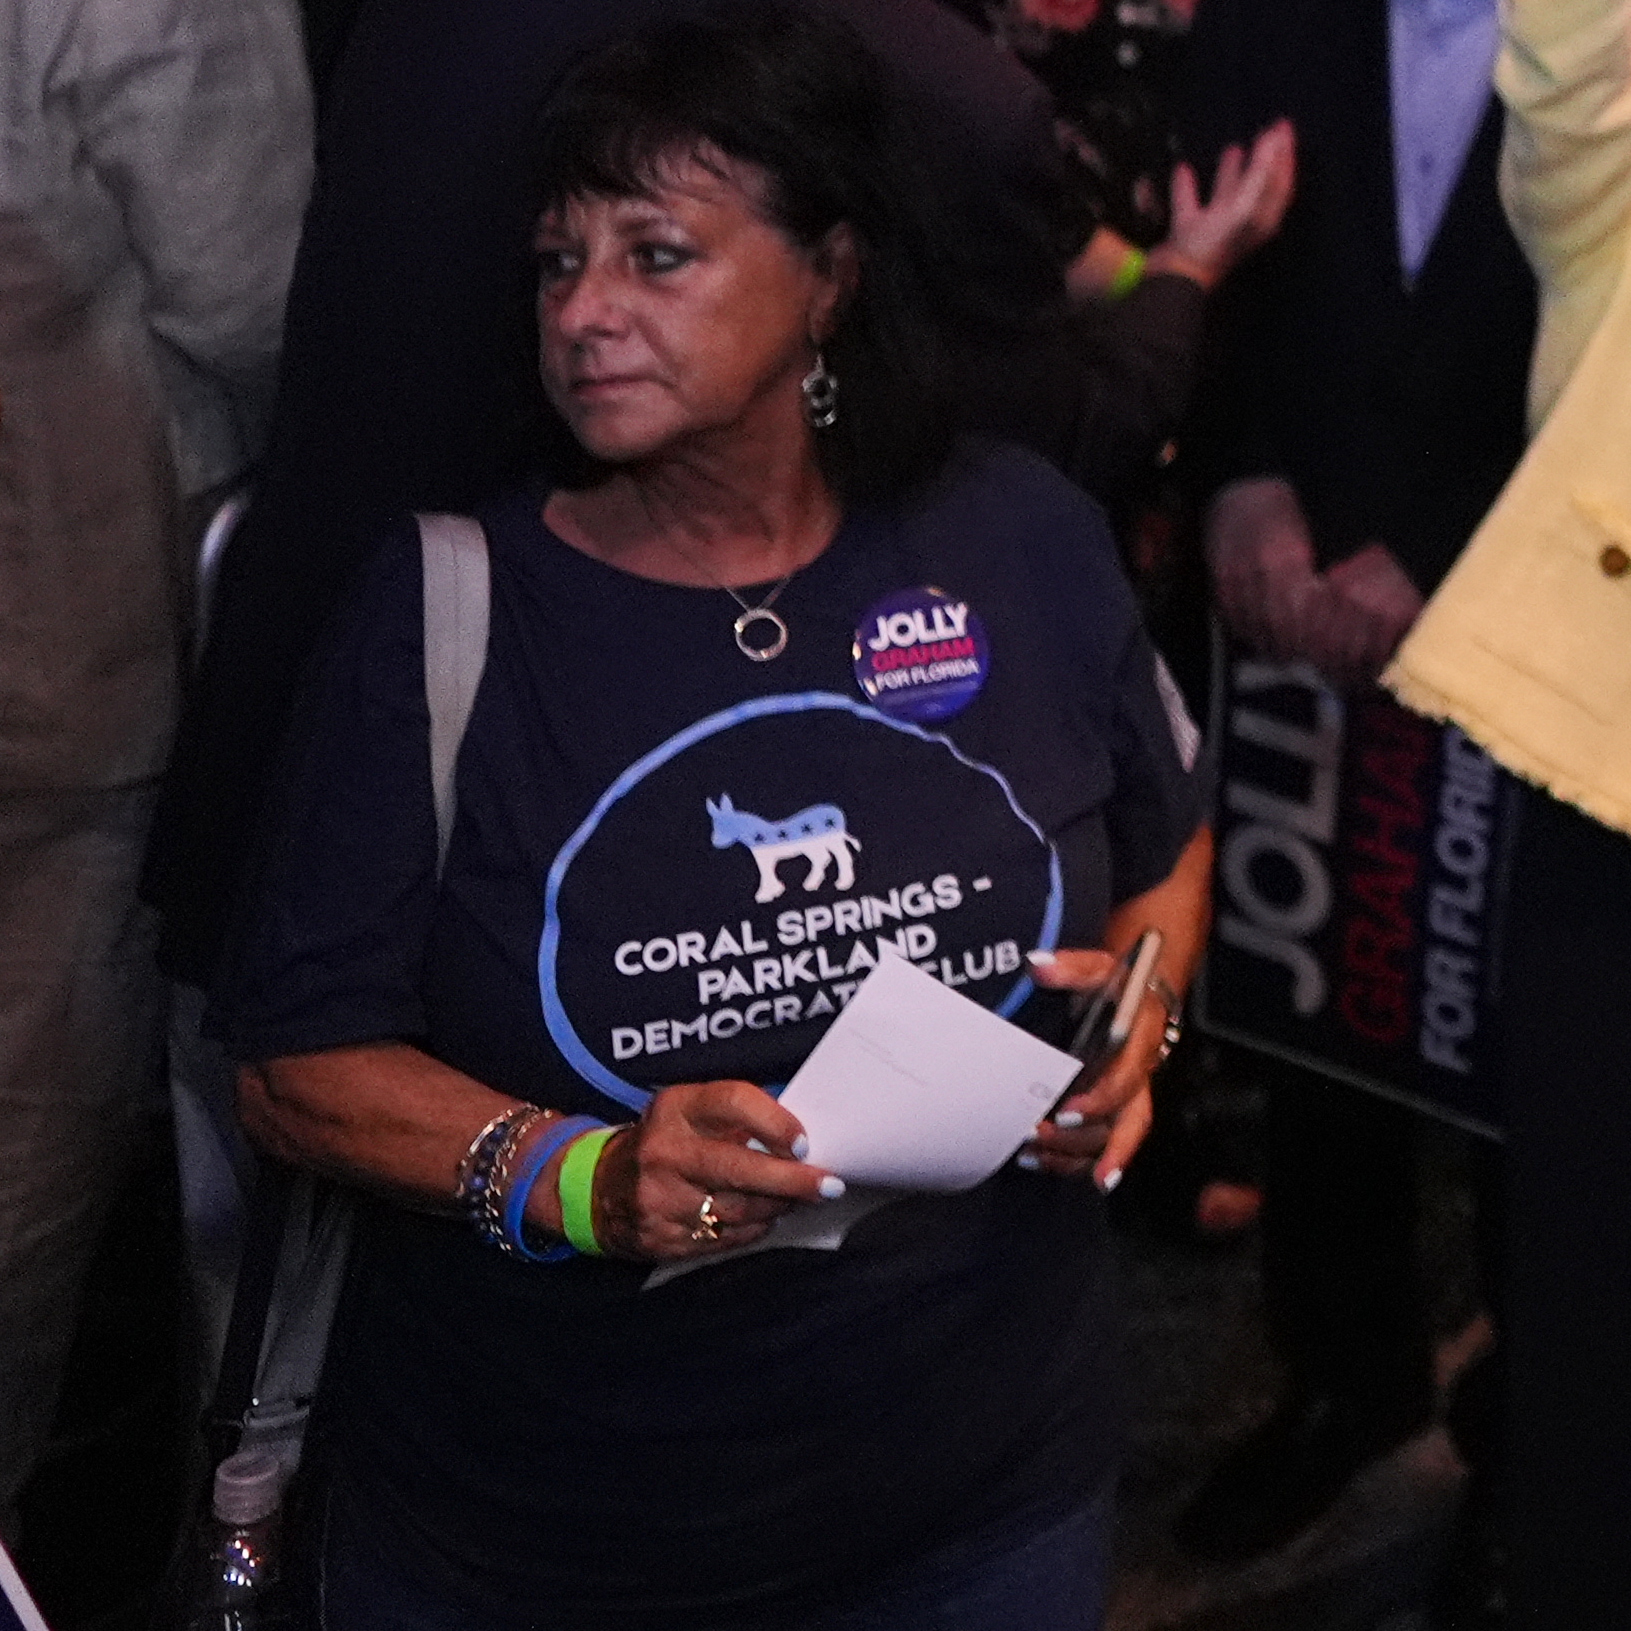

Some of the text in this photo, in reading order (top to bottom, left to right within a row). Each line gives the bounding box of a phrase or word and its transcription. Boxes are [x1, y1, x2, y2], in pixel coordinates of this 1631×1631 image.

[867, 601, 969, 652] JOLLY
[614, 920, 769, 977] CORAL
[776, 873, 963, 946] SPRINGS
[1337, 707, 1434, 1045] GRAHA
[1419, 725, 1498, 1076] FOR FLORID
[611, 938, 1022, 1062] DEMOCRAT LUB
[697, 922, 938, 1006] PARKLAND
